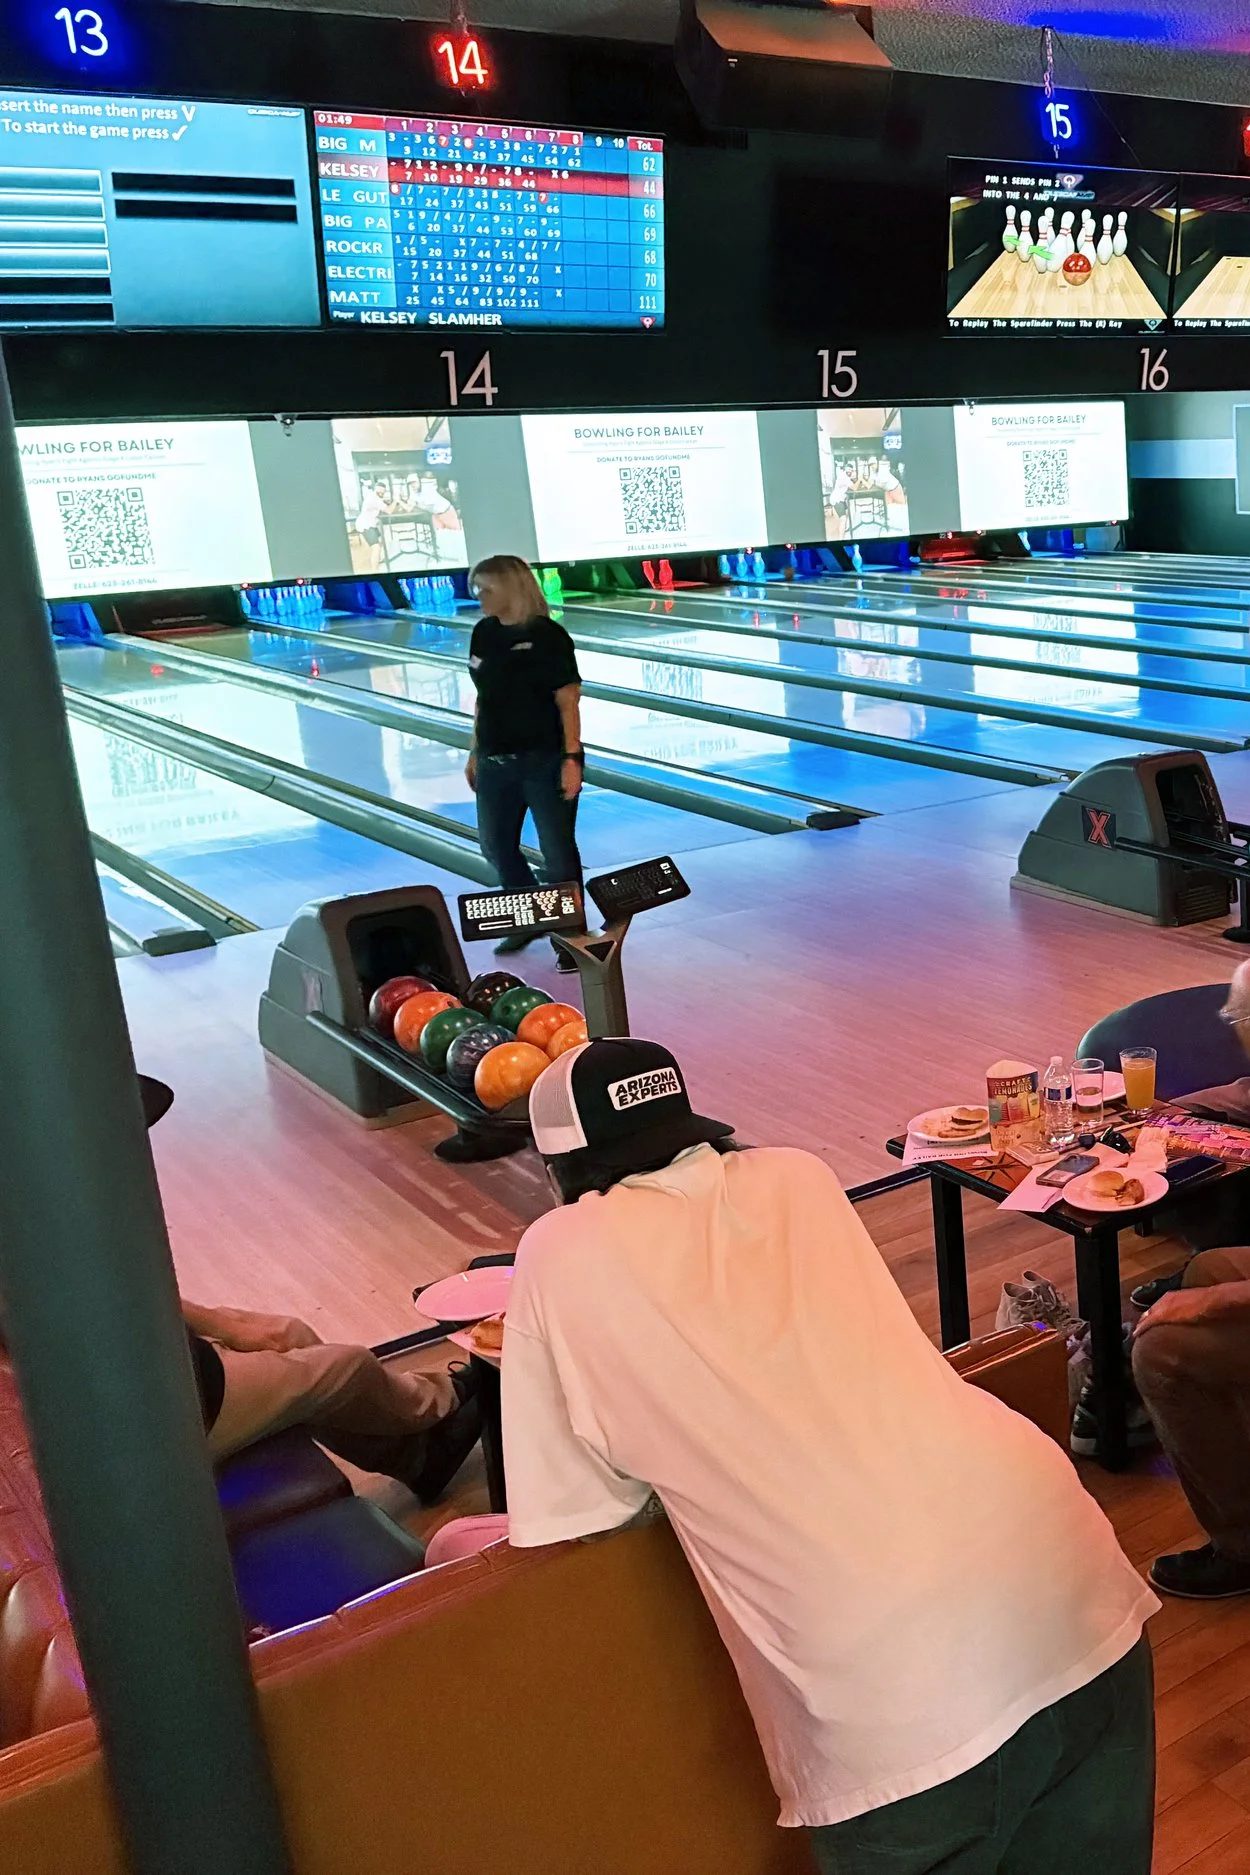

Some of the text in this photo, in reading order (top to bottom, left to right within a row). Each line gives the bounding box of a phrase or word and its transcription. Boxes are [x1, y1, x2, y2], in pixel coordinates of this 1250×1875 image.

[54, 7, 109, 57] 13
[438, 40, 488, 85] 14
[0, 99, 196, 124] sert the name then press V
[1045, 103, 1073, 139] 15
[0, 118, 169, 142] To start the game press
[318, 113, 353, 125] 01:49
[401, 120, 408, 131] 1
[426, 122, 434, 133] 2
[451, 124, 459, 135] 3
[476, 126, 484, 137] 4
[502, 128, 509, 139] 5
[525, 130, 532, 141] 6
[549, 132, 556, 142] 7
[572, 134, 579, 145] 8
[596, 136, 603, 147] 9
[613, 137, 624, 149] 10
[318, 136, 377, 152] BIG M
[422, 147, 581, 168] 12 21 29 37 45 54 62
[643, 157, 656, 172] 62
[320, 162, 379, 178] KELSEY
[423, 173, 536, 189] 10 19 29 36 44
[643, 181, 656, 195] 44
[985, 174, 999, 184] PIN
[1002, 176, 1008, 185] 1
[1011, 176, 1035, 186] SENDS
[1038, 178, 1052, 187] PIN
[322, 189, 388, 204] LE GUT
[983, 189, 1002, 199] INTO
[1006, 190, 1020, 200] THE
[1023, 191, 1029, 200] 4
[1033, 192, 1050, 201] AND
[400, 196, 560, 214] 17 24 37 43 51 59 66
[643, 203, 656, 219] 66
[324, 214, 389, 230] BIG PA
[408, 222, 561, 239] 6 20 37 44 53 60 69
[644, 227, 657, 242] 69
[326, 240, 383, 254] ROCKR
[644, 250, 657, 265] 68
[328, 265, 393, 280] ELECTRI
[645, 273, 657, 288] 70
[330, 290, 380, 304] MATT
[639, 295, 657, 309] 111
[360, 311, 418, 325] KELSEY
[428, 311, 503, 326] SLAMHER
[949, 319, 960, 327] To
[962, 319, 989, 329] Replay
[993, 319, 1007, 327] The
[1056, 320, 1076, 328] Press
[1079, 320, 1093, 328] The
[1109, 320, 1123, 329] Key
[1174, 319, 1183, 327] To
[1185, 319, 1207, 328] Replay
[1210, 319, 1222, 327] The
[816, 349, 858, 398] 15
[1140, 347, 1170, 391] 16
[440, 350, 499, 406] 14
[992, 414, 1087, 426] BOWLING FOR BAILEY
[574, 425, 704, 438] BOWLING FOR BAILEY
[18, 438, 174, 455] WLING FOR BAILEY
[25, 476, 61, 485] DONATE
[63, 476, 76, 484] TO
[615, 1070, 676, 1097] ARIZONA
[618, 1081, 678, 1107] EXPERTS
